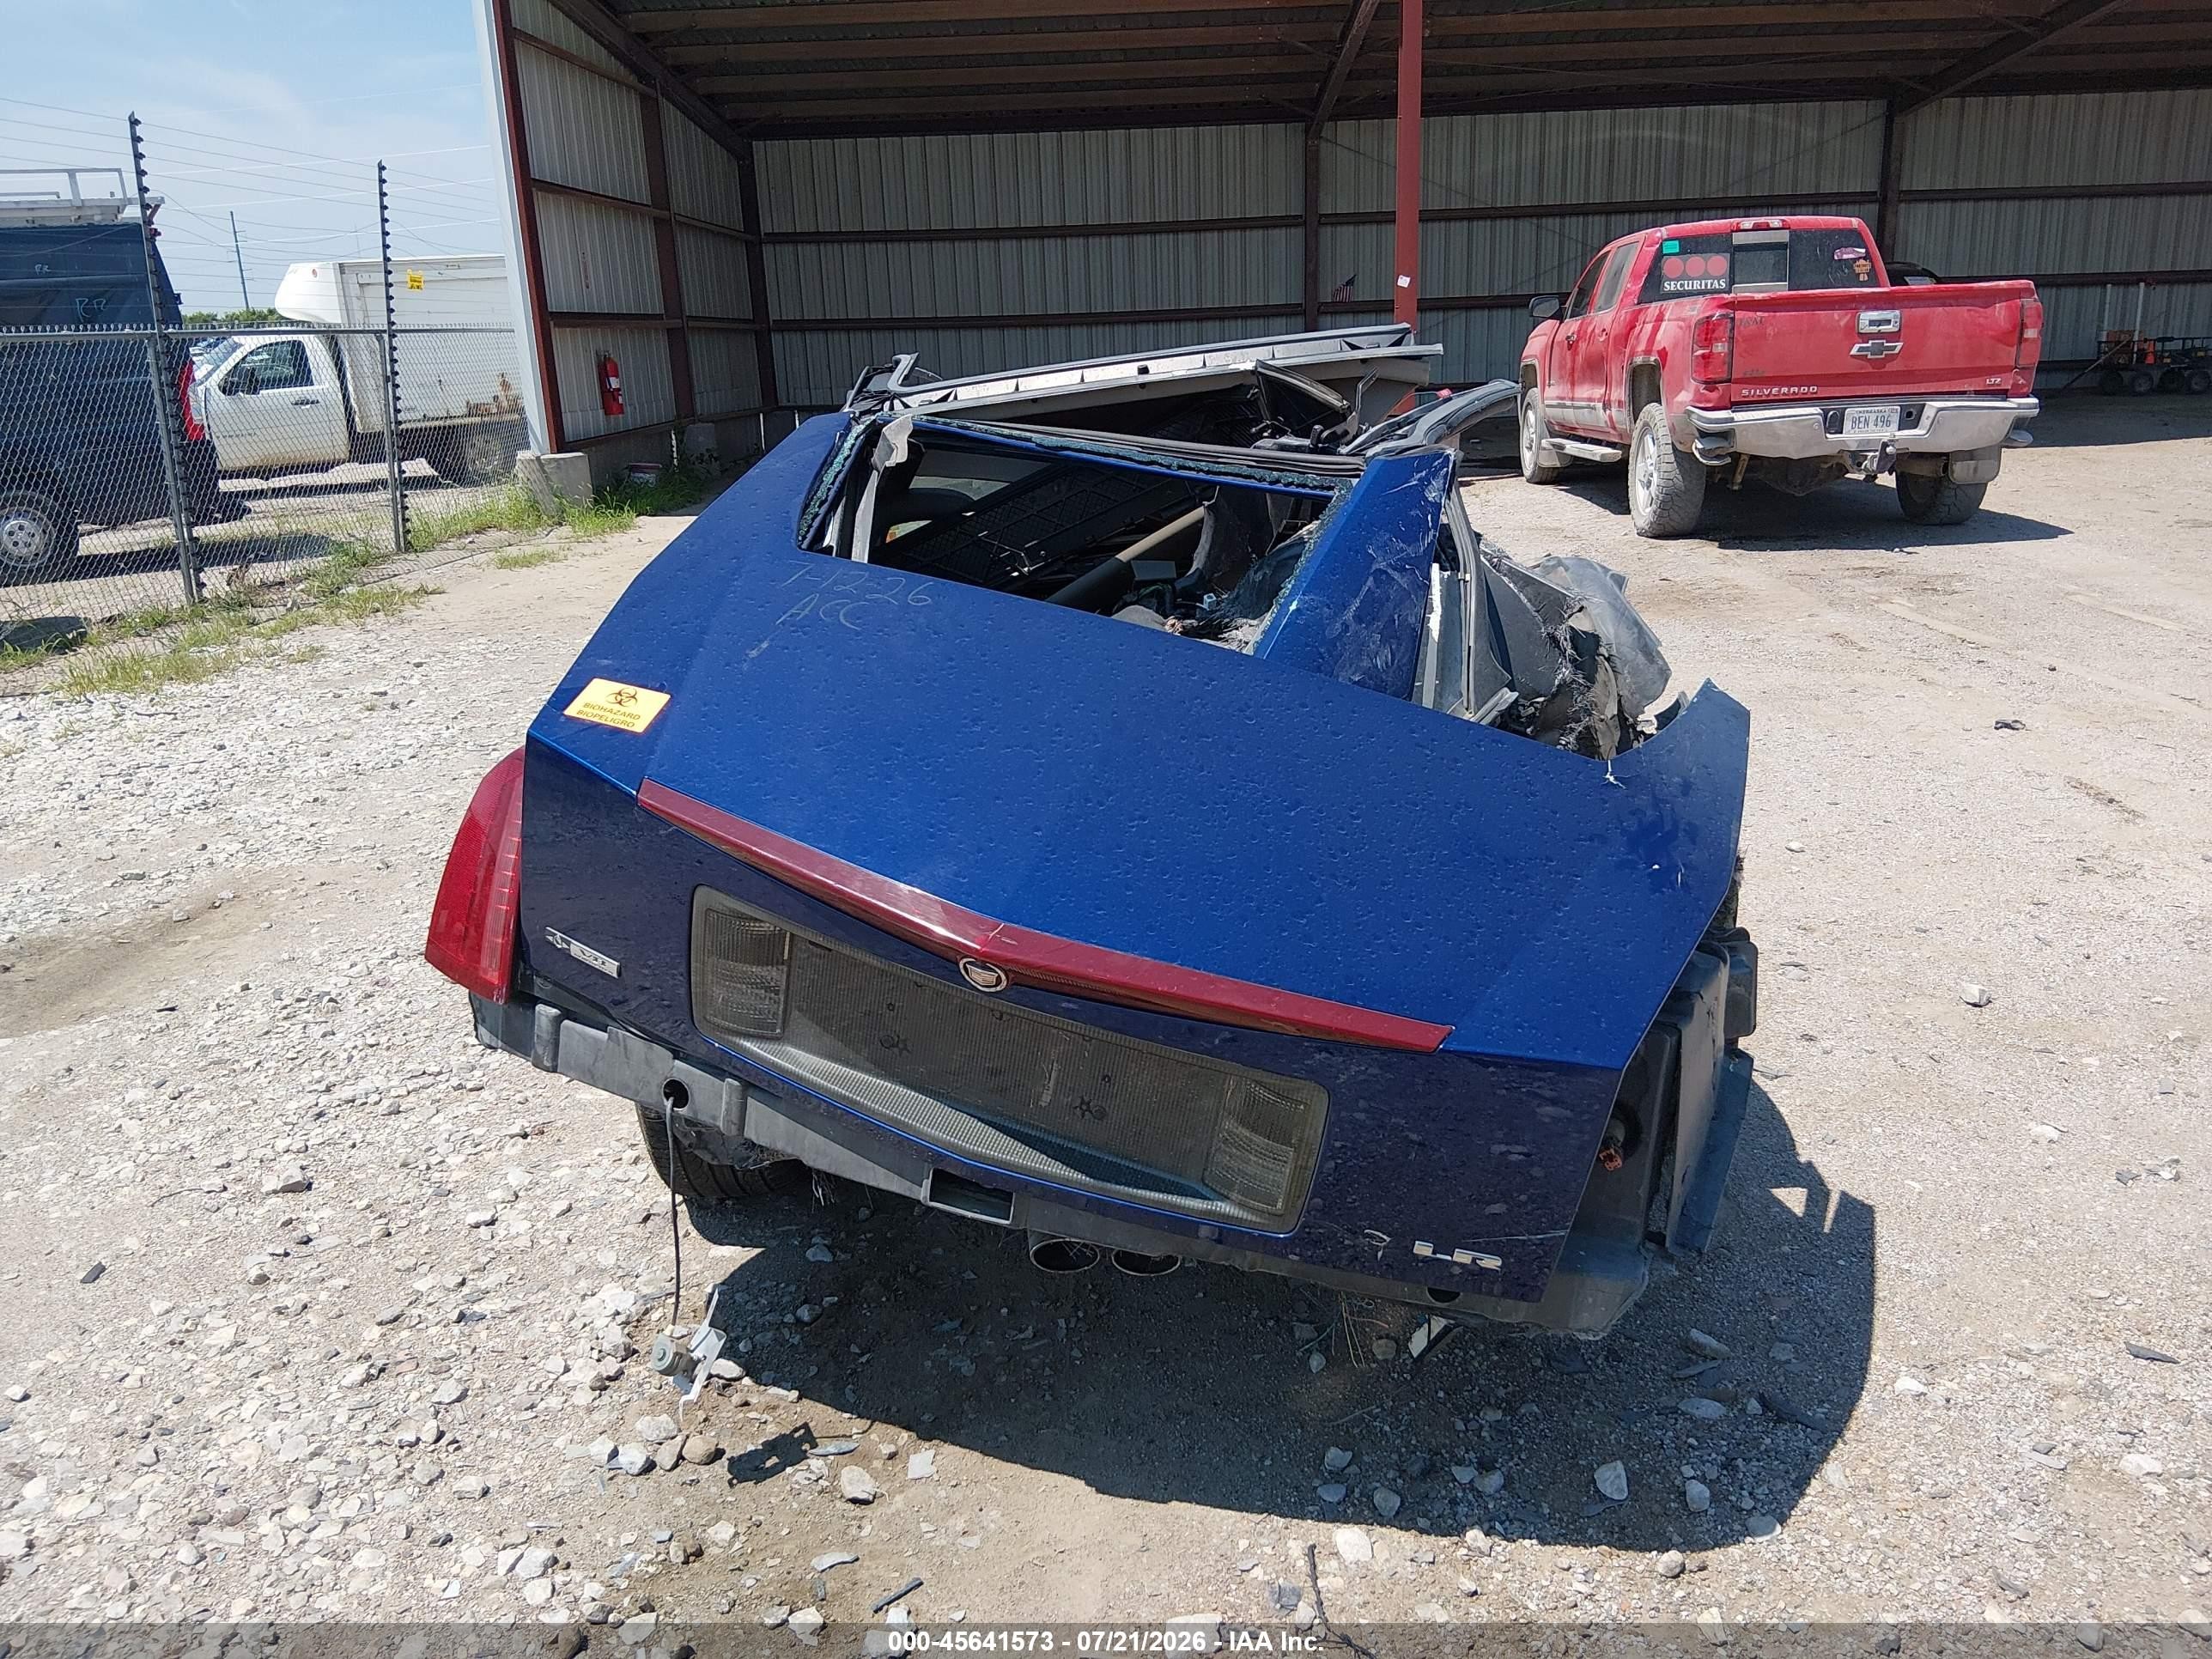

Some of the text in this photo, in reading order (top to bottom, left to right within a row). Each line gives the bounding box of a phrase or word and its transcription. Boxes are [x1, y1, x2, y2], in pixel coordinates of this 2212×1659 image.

[1663, 279, 1726, 291] SECURITAS
[1741, 386, 1818, 396] SILVERADO
[1851, 414, 1891, 429] BEN 496
[781, 560, 934, 606] 7-12-26
[775, 592, 871, 630] ACC
[576, 709, 635, 728] BIOPELIGRO
[583, 702, 641, 720] BIOHAZARD
